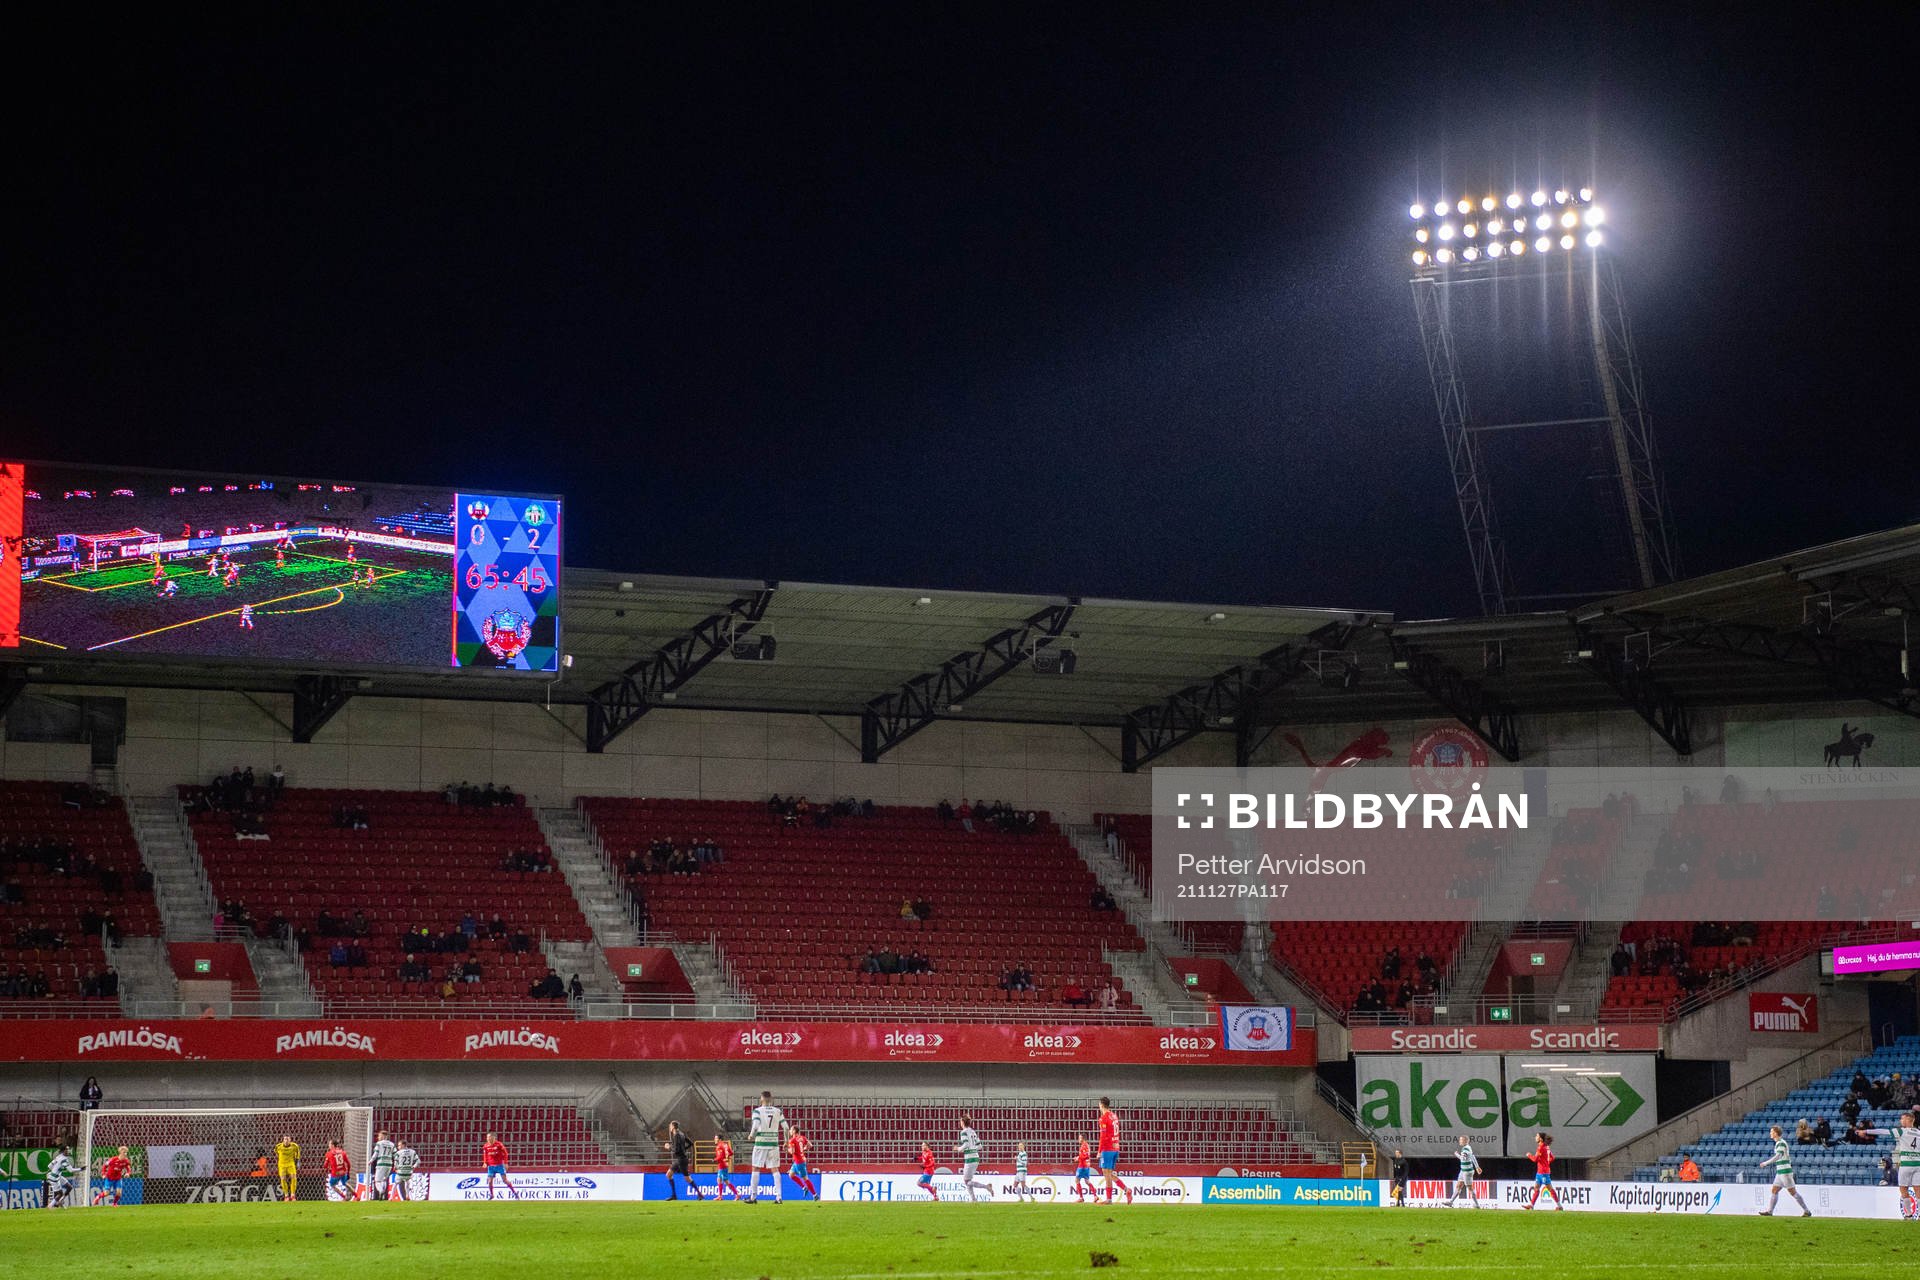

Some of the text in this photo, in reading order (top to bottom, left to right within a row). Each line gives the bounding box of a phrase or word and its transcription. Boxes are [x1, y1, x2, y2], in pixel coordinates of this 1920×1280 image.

[470, 524, 485, 546] 0
[527, 528, 541, 549] 2
[465, 563, 547, 593] 65:45
[1753, 1011, 1800, 1031] PUMA
[77, 1026, 182, 1055] RAMLÖSA
[276, 1026, 376, 1054] RAMLÖSA
[465, 1026, 560, 1055] RAMLÖSA
[740, 1029, 783, 1045] akea
[884, 1030, 925, 1046] akea
[1023, 1032, 1064, 1048] akea
[1159, 1034, 1199, 1049] akea
[1391, 1028, 1478, 1049] Scandic
[1530, 1027, 1620, 1048] Scandic
[1360, 1062, 1553, 1129] akea
[767, 1115, 774, 1129] 7
[1383, 1135, 1498, 1144] PART OF ELEDA ROUP
[1910, 1136, 1917, 1150] 4
[507, 1188, 552, 1199] BÖRCK
[574, 1190, 589, 1199] AB
[839, 1180, 893, 1201] CBH
[1133, 1186, 1181, 1197] Nobina
[1208, 1184, 1372, 1202] Assemblin Assemblin
[1410, 1181, 1444, 1199] MVM
[1555, 1186, 1592, 1205] TAPET
[1609, 1185, 1709, 1211] Kapitalgruppen
